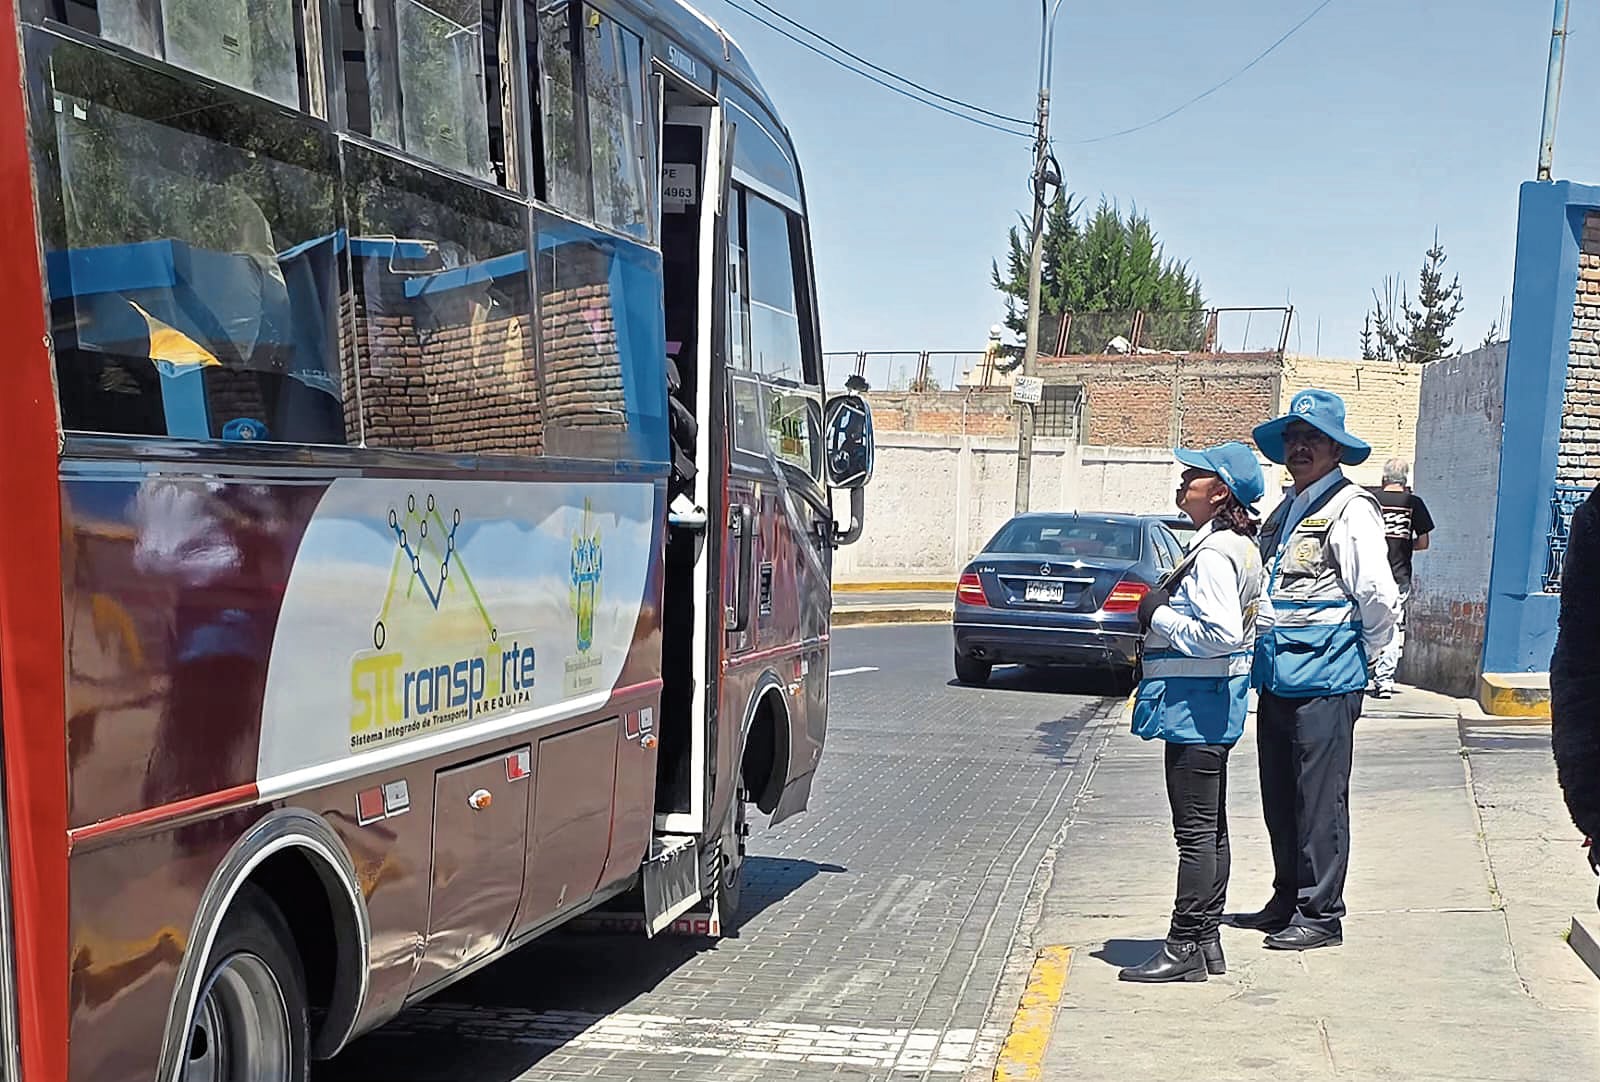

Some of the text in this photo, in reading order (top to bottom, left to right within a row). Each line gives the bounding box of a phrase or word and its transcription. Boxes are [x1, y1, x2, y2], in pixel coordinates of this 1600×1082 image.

[664, 187, 692, 198] 4963
[475, 691, 530, 714] AREQUIPA
[351, 708, 468, 747] Sistema Integrado de Transporte
